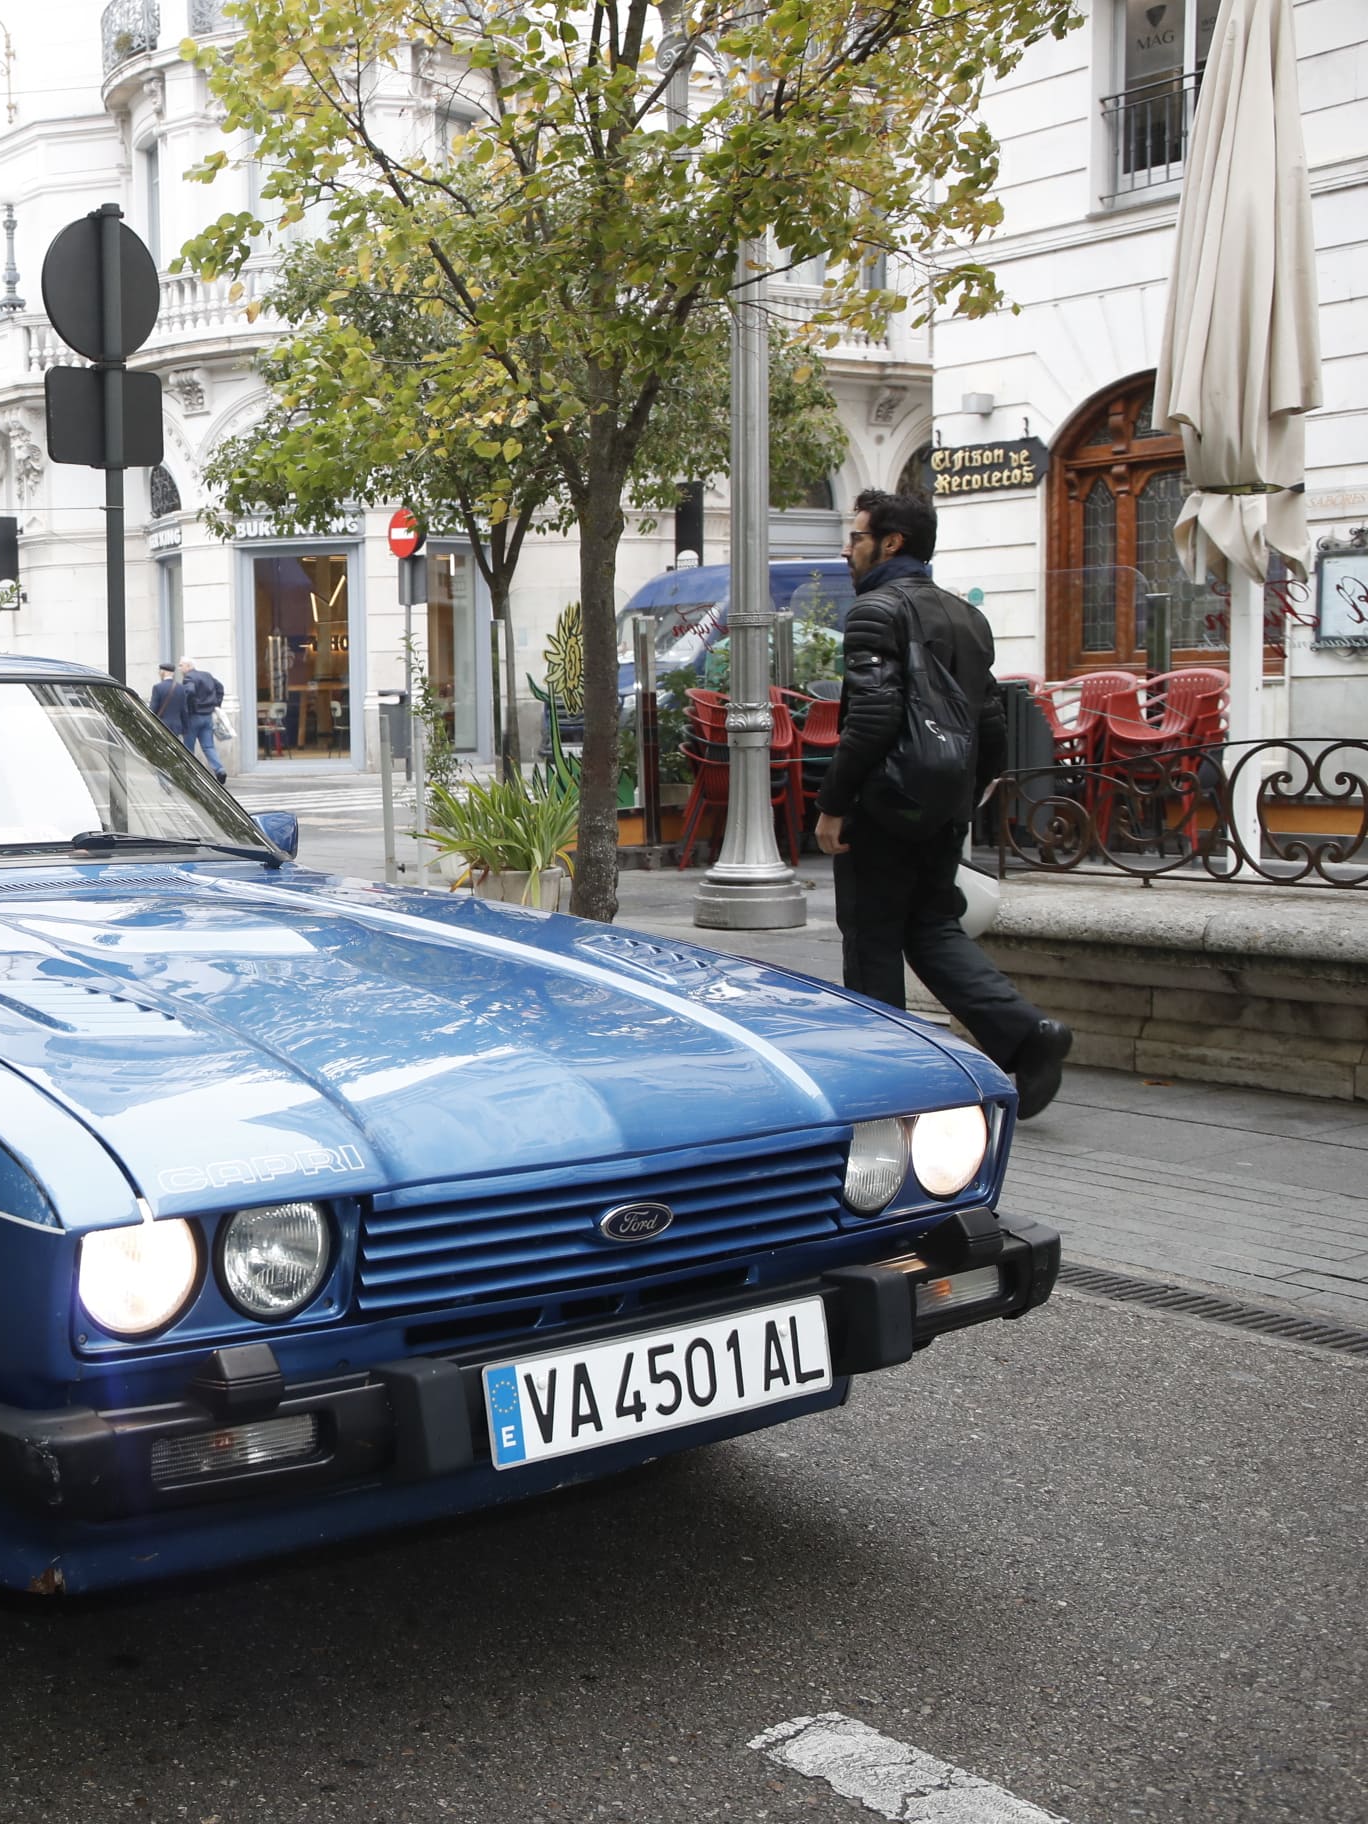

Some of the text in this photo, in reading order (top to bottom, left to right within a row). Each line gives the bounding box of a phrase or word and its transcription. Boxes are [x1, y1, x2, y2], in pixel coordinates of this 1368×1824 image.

[1136, 30, 1175, 50] MAG
[931, 450, 951, 471] El
[1008, 449, 1032, 467] de
[933, 463, 1037, 494] Recoletos
[158, 1144, 365, 1194] CAPRI
[619, 1210, 658, 1233] Ford
[524, 1315, 826, 1444] VA 4501 AL
[501, 1425, 517, 1449] E
